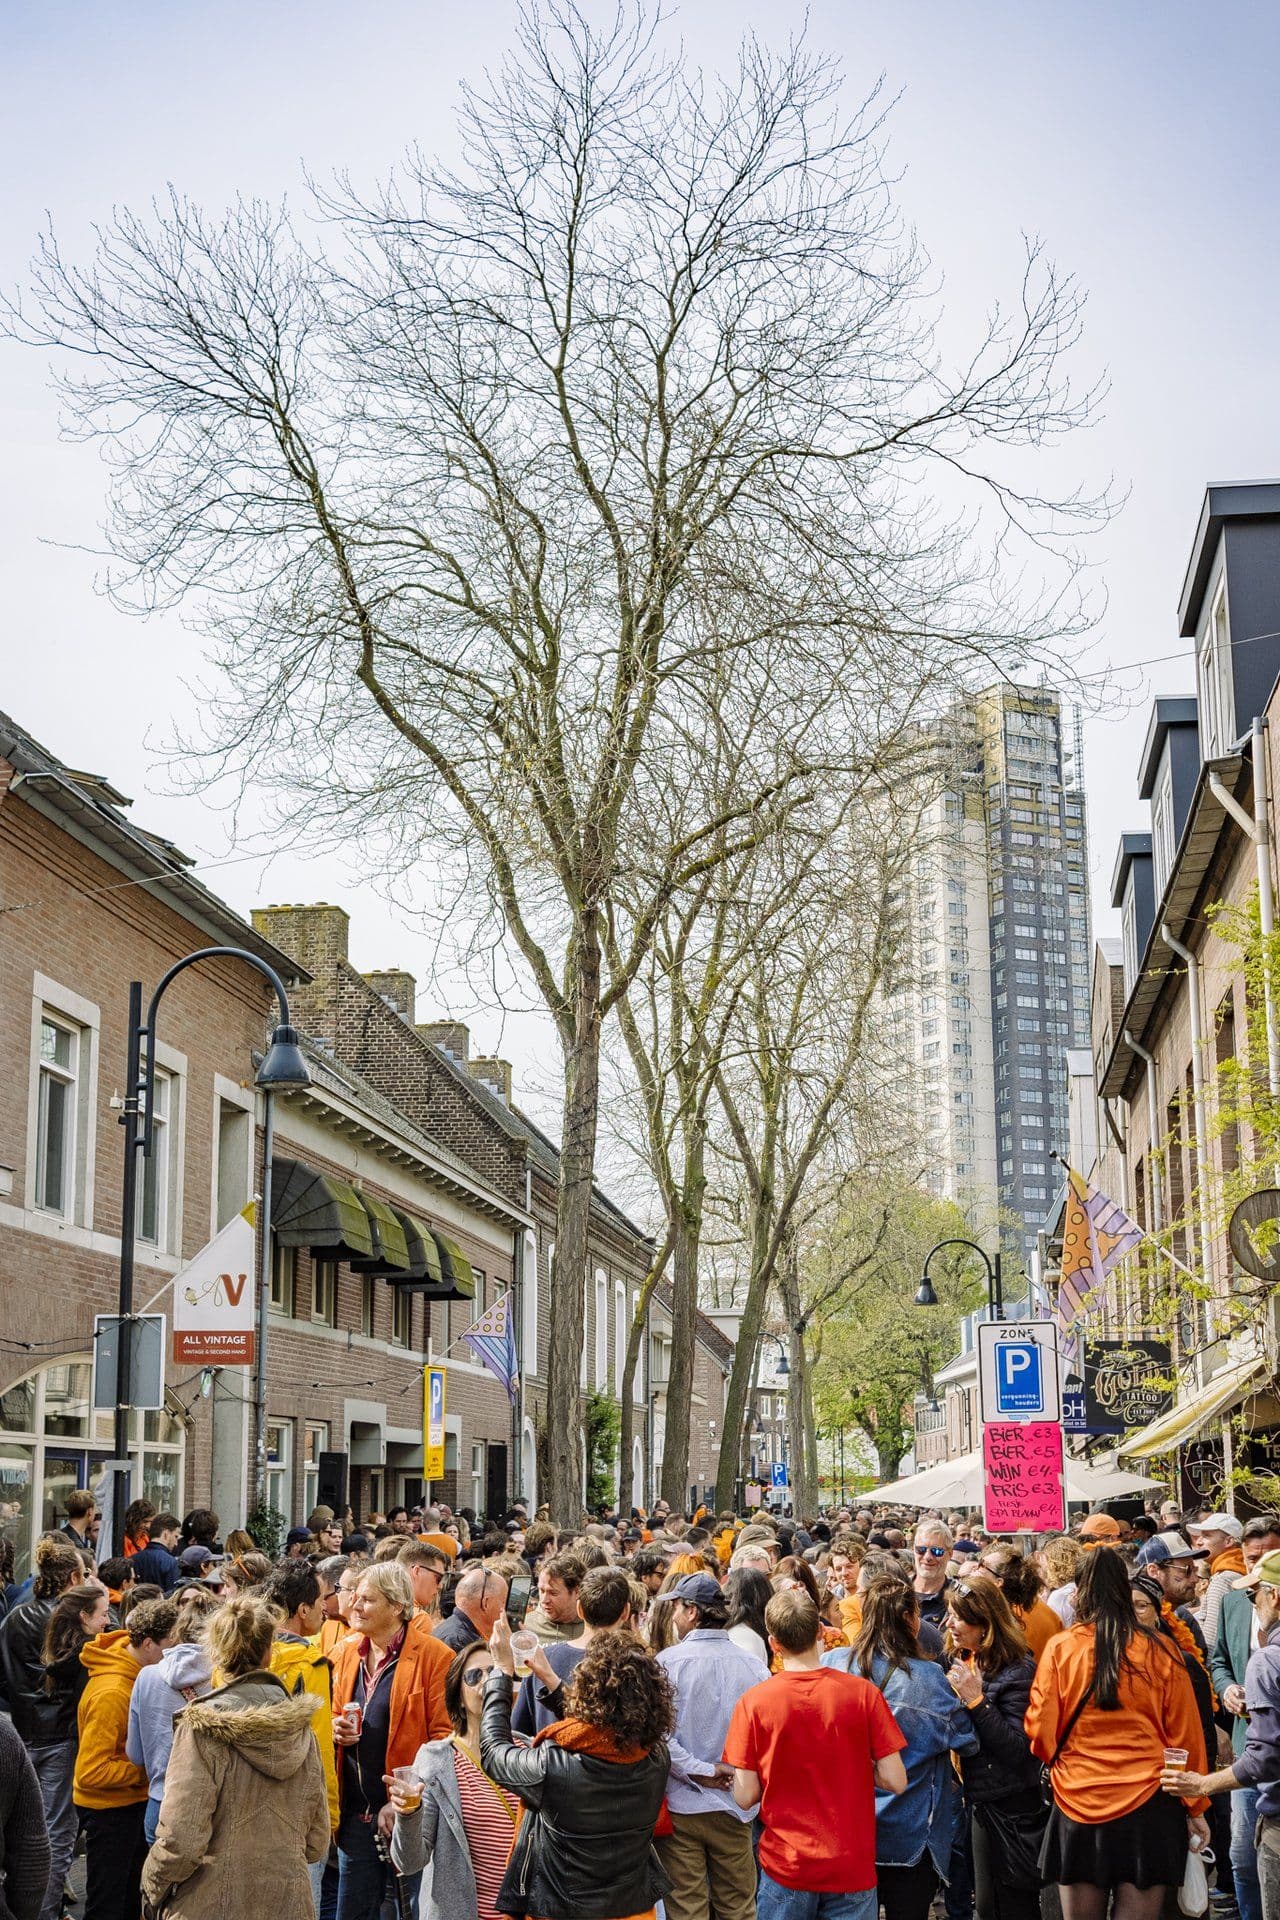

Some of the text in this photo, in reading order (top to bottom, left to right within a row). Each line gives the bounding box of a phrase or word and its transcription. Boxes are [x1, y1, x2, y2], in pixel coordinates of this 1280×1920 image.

[183, 1336, 246, 1344] ALL VINTAGE
[1005, 1348, 1031, 1385] P
[432, 1378, 441, 1419] P
[1126, 1392, 1158, 1402] TATTOO
[775, 1465, 783, 1476] P
